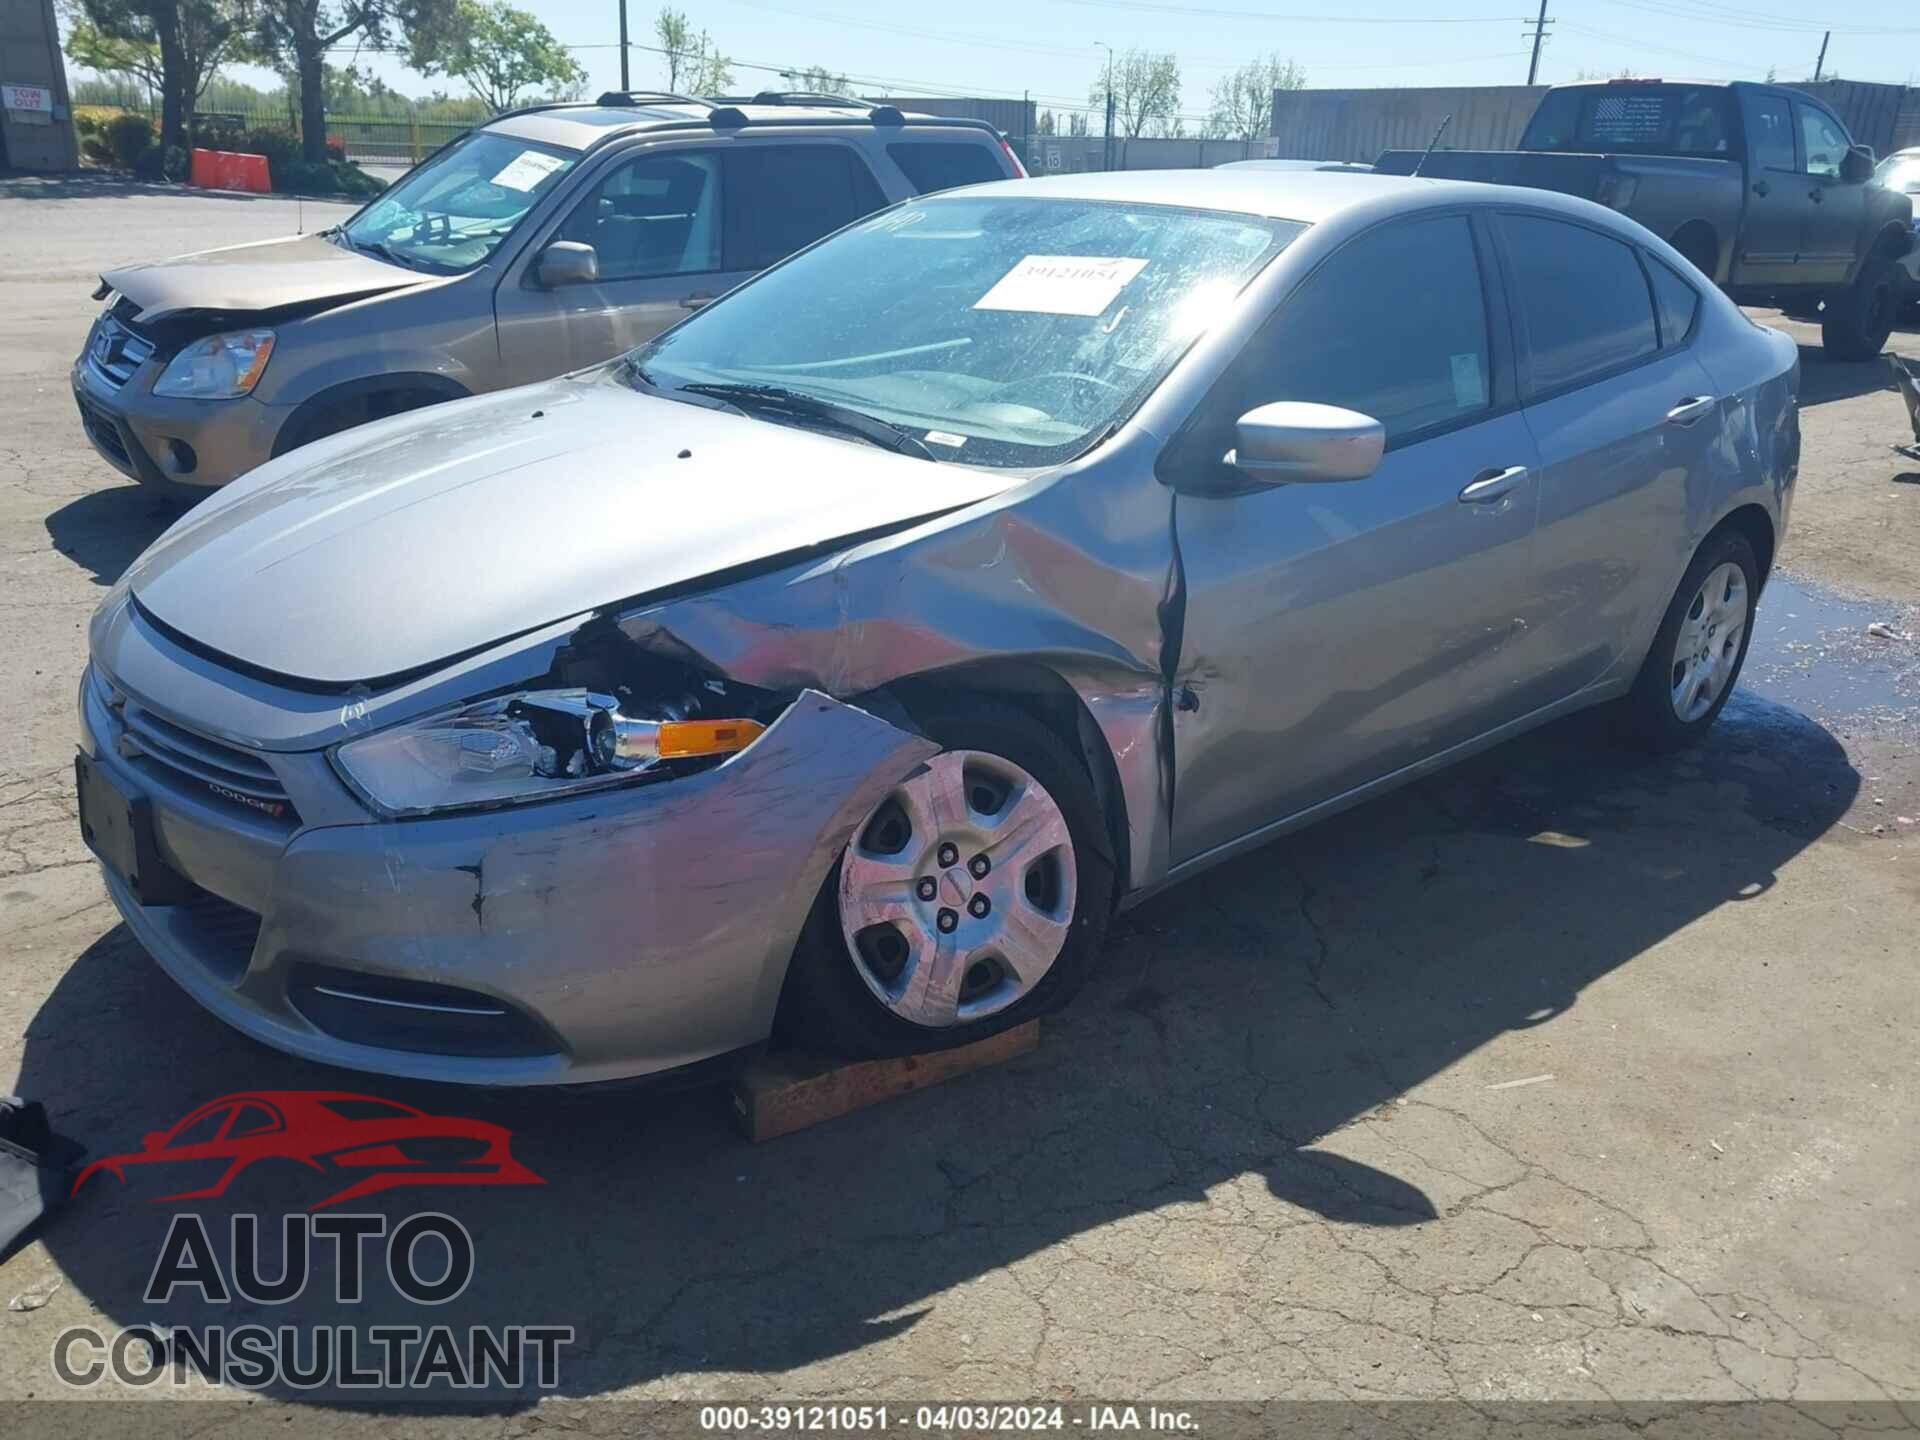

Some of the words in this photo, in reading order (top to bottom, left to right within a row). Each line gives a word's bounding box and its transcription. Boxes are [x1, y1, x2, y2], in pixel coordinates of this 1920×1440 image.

[13, 88, 41, 98] TOW
[14, 98, 41, 109] OUT
[208, 783, 274, 813] DODGE
